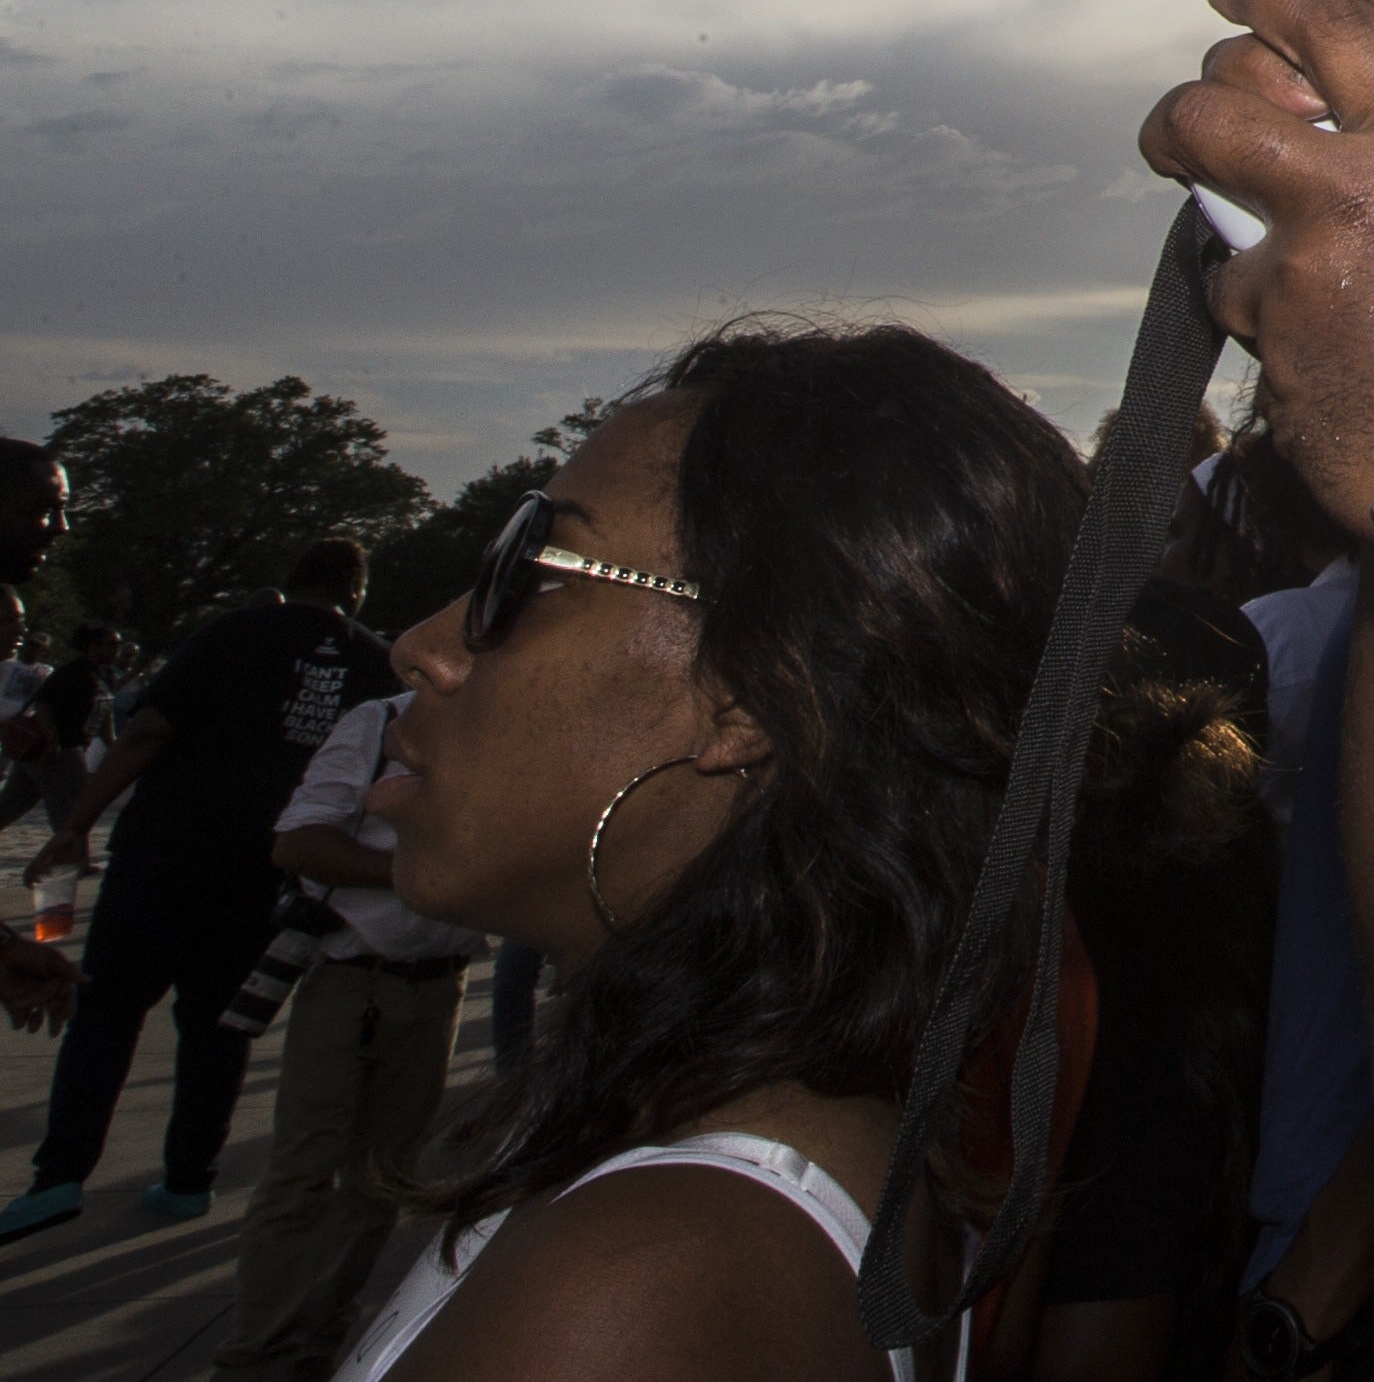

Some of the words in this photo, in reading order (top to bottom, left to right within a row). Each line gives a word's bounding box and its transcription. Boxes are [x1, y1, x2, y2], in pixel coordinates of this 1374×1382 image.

[302, 676, 343, 693] KEEP
[299, 688, 341, 707] CALM
[289, 701, 337, 721] HAVE
